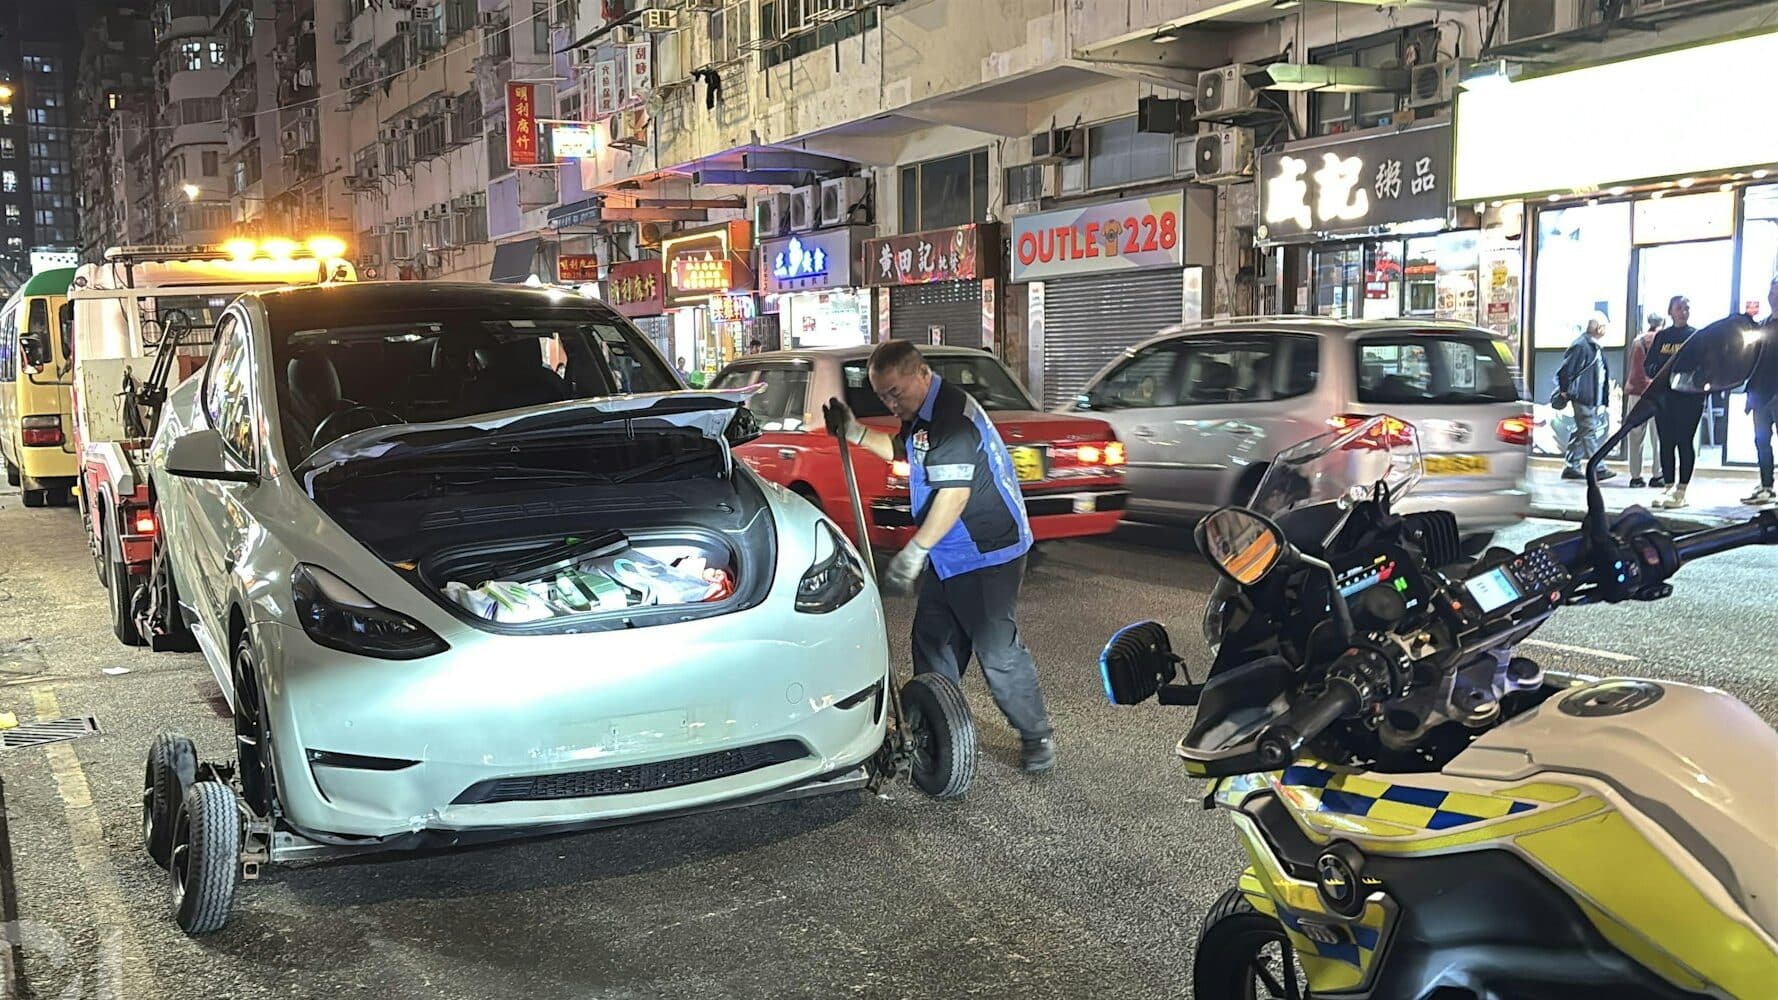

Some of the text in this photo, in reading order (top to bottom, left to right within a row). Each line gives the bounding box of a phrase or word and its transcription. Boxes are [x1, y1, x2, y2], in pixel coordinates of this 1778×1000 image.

[514, 86, 531, 151] 明利腐竹
[1123, 211, 1177, 254] 228
